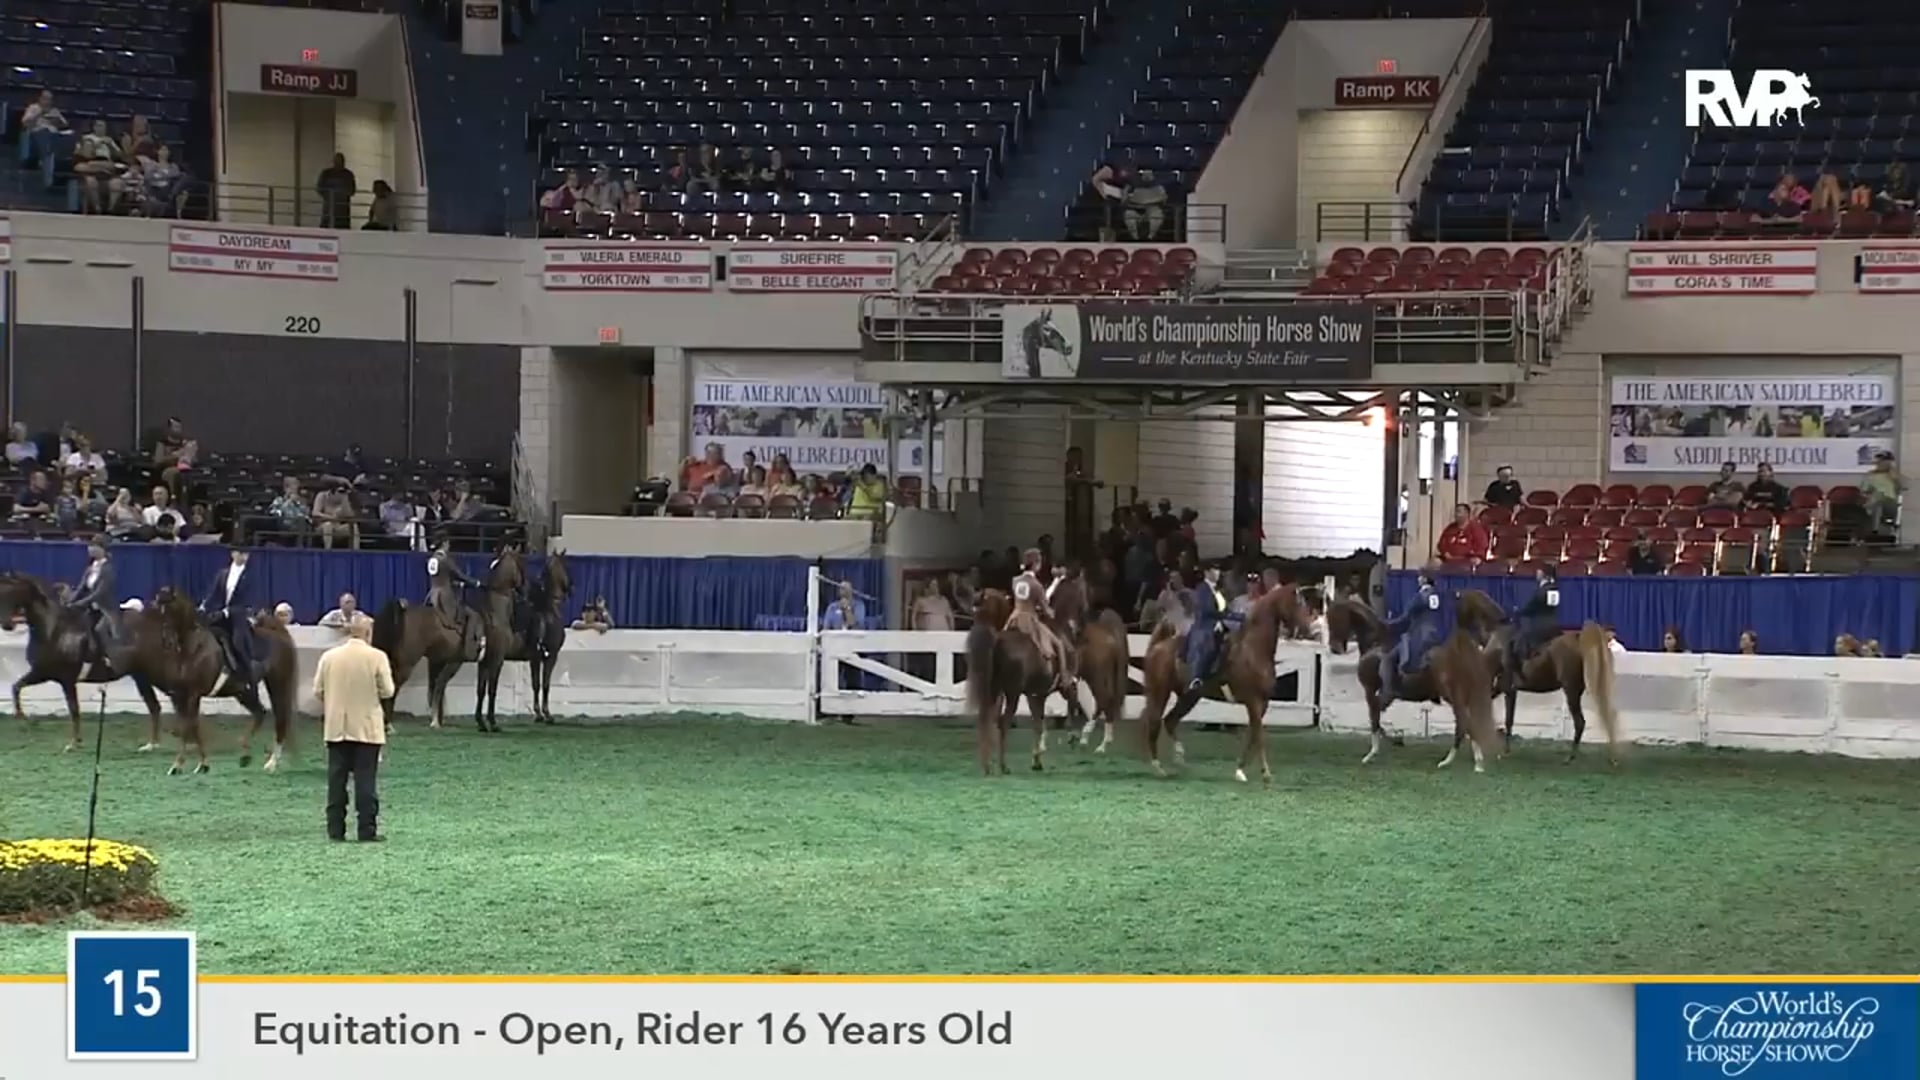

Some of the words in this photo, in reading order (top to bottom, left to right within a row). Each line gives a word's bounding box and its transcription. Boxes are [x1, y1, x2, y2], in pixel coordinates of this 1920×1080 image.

[271, 69, 321, 91] Ramp
[328, 73, 348, 90] JJ
[1343, 82, 1396, 101] Ramp
[1404, 80, 1431, 97] KK
[219, 234, 292, 250] DAYDREAM
[234, 258, 252, 271] MY
[257, 259, 276, 272] MY
[580, 252, 625, 263] VALERIA
[629, 252, 683, 263] EMERALD
[780, 253, 846, 265] SUREFIRE
[1666, 253, 1702, 265] WILL
[1708, 252, 1774, 265] SHRIVER
[580, 274, 651, 286] YORKTOWN
[761, 276, 801, 288] BELLE
[806, 277, 865, 289] ELEGANT
[1674, 276, 1732, 289] CORA'S
[1740, 276, 1775, 289] TIME
[285, 315, 321, 334] 220
[1089, 315, 1148, 343] World's
[1152, 315, 1261, 348] Championship
[1266, 316, 1313, 343] Horse
[1319, 315, 1363, 343] Show
[1138, 351, 1152, 365] at
[1155, 351, 1176, 365] the
[1180, 350, 1242, 368] Kentucky
[1246, 350, 1280, 366] State
[1283, 350, 1311, 366] Fair
[704, 384, 736, 402] THE
[740, 384, 822, 403] AMERICAN
[1625, 383, 1658, 401] THE
[1663, 383, 1755, 401] AMERICAN
[1760, 383, 1883, 402] SADDLEBRED
